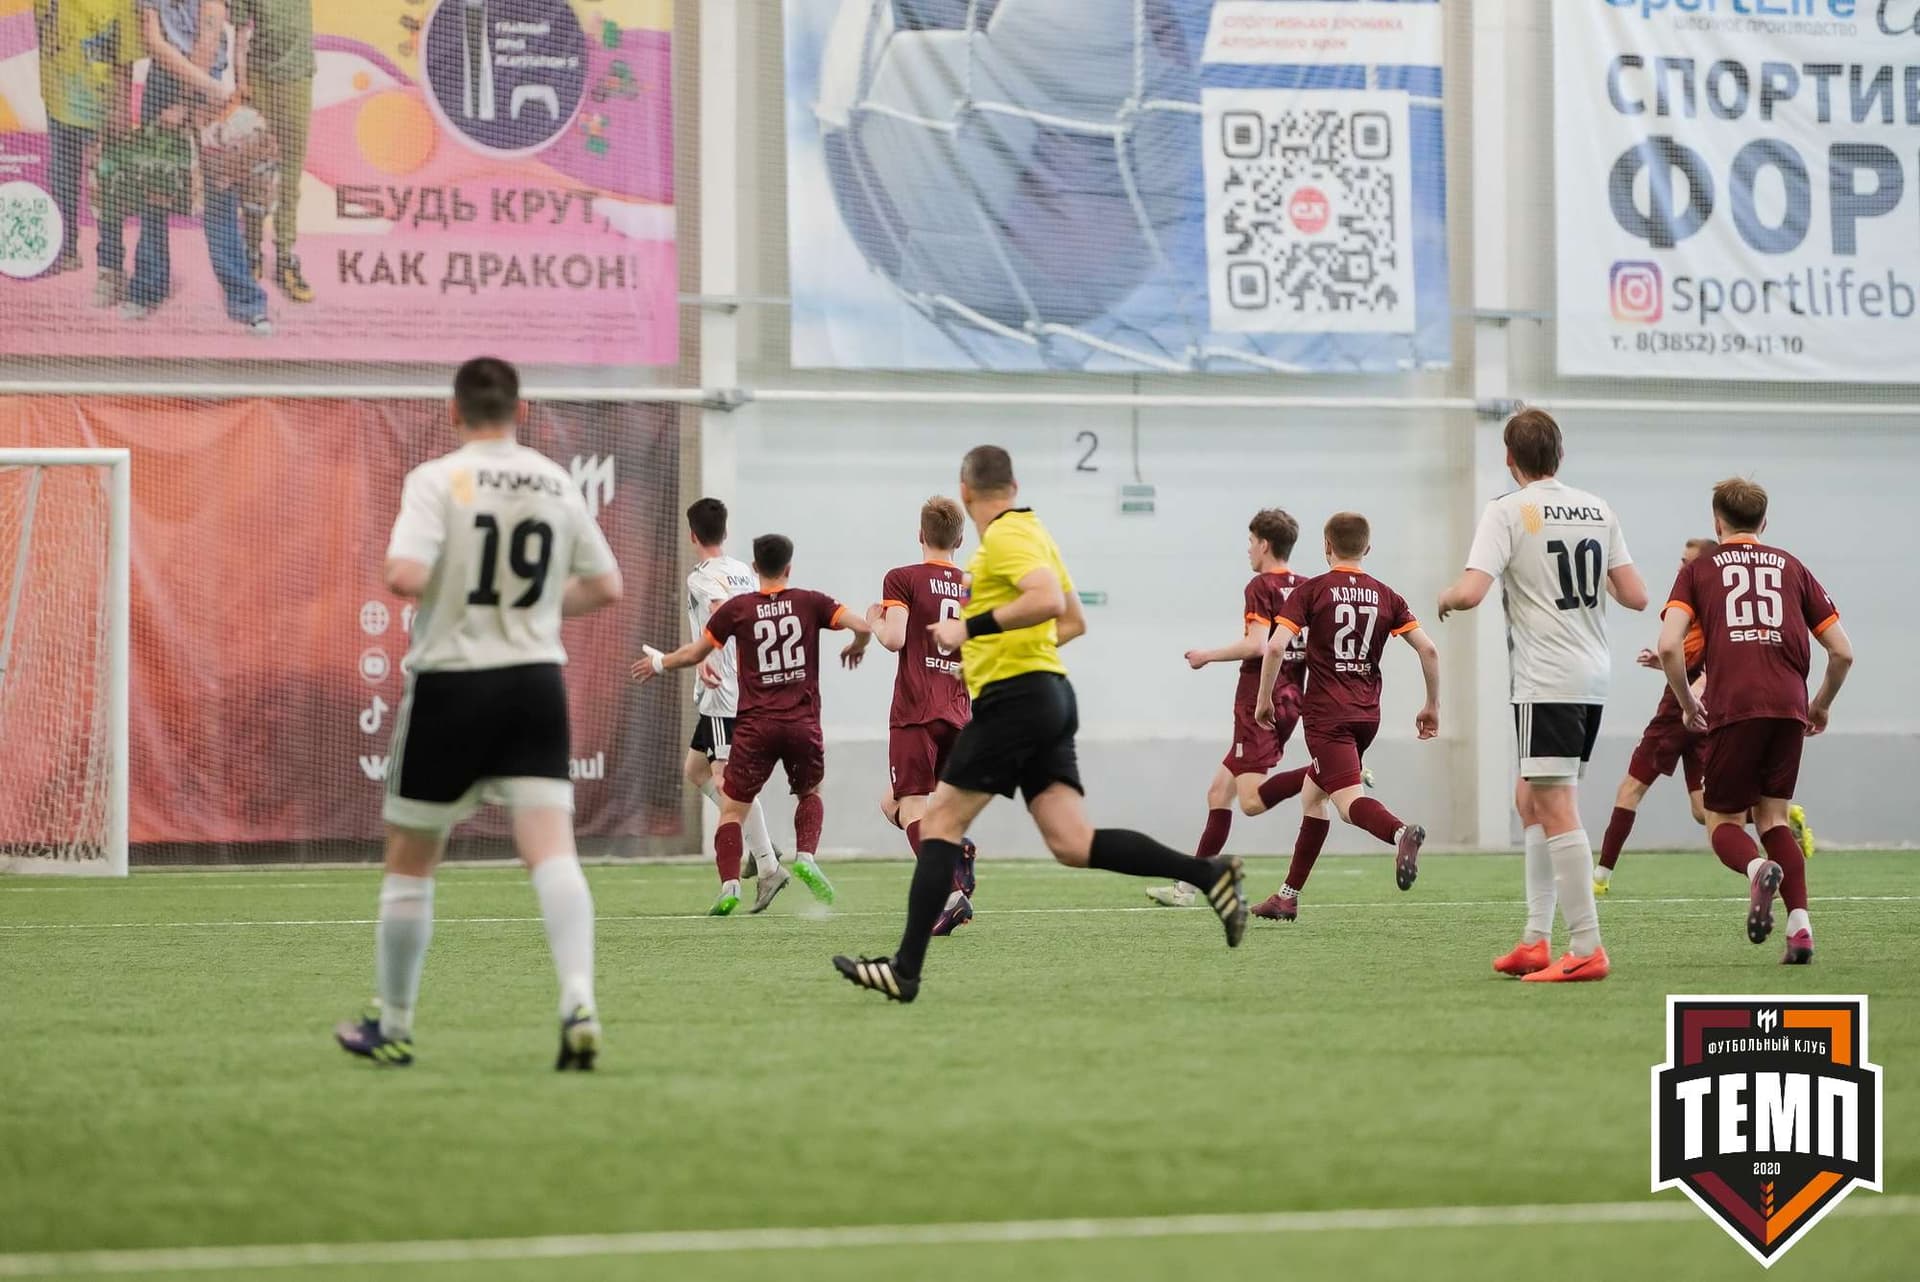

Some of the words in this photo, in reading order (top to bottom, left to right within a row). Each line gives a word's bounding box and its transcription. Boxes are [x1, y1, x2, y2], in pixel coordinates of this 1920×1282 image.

[336, 184, 476, 229] БУДЬ
[490, 187, 610, 233] КРУТ,
[1608, 136, 1920, 255] ФОР
[337, 249, 427, 285] КАК
[440, 251, 637, 294] ДРАКОН!
[1076, 430, 1099, 473] 2
[1544, 505, 1604, 522] АЛМАЗ
[467, 514, 554, 608] 19
[1547, 538, 1603, 611] 10
[1712, 550, 1786, 569] НОВИЧКОВ
[756, 599, 793, 620] БАБИЧ
[1330, 586, 1379, 605] ЖДАНОВ
[1722, 565, 1784, 628] 25
[753, 615, 806, 673] 22
[1334, 603, 1378, 660] 27
[1729, 629, 1783, 643] SEUS
[761, 668, 807, 685] SEUS
